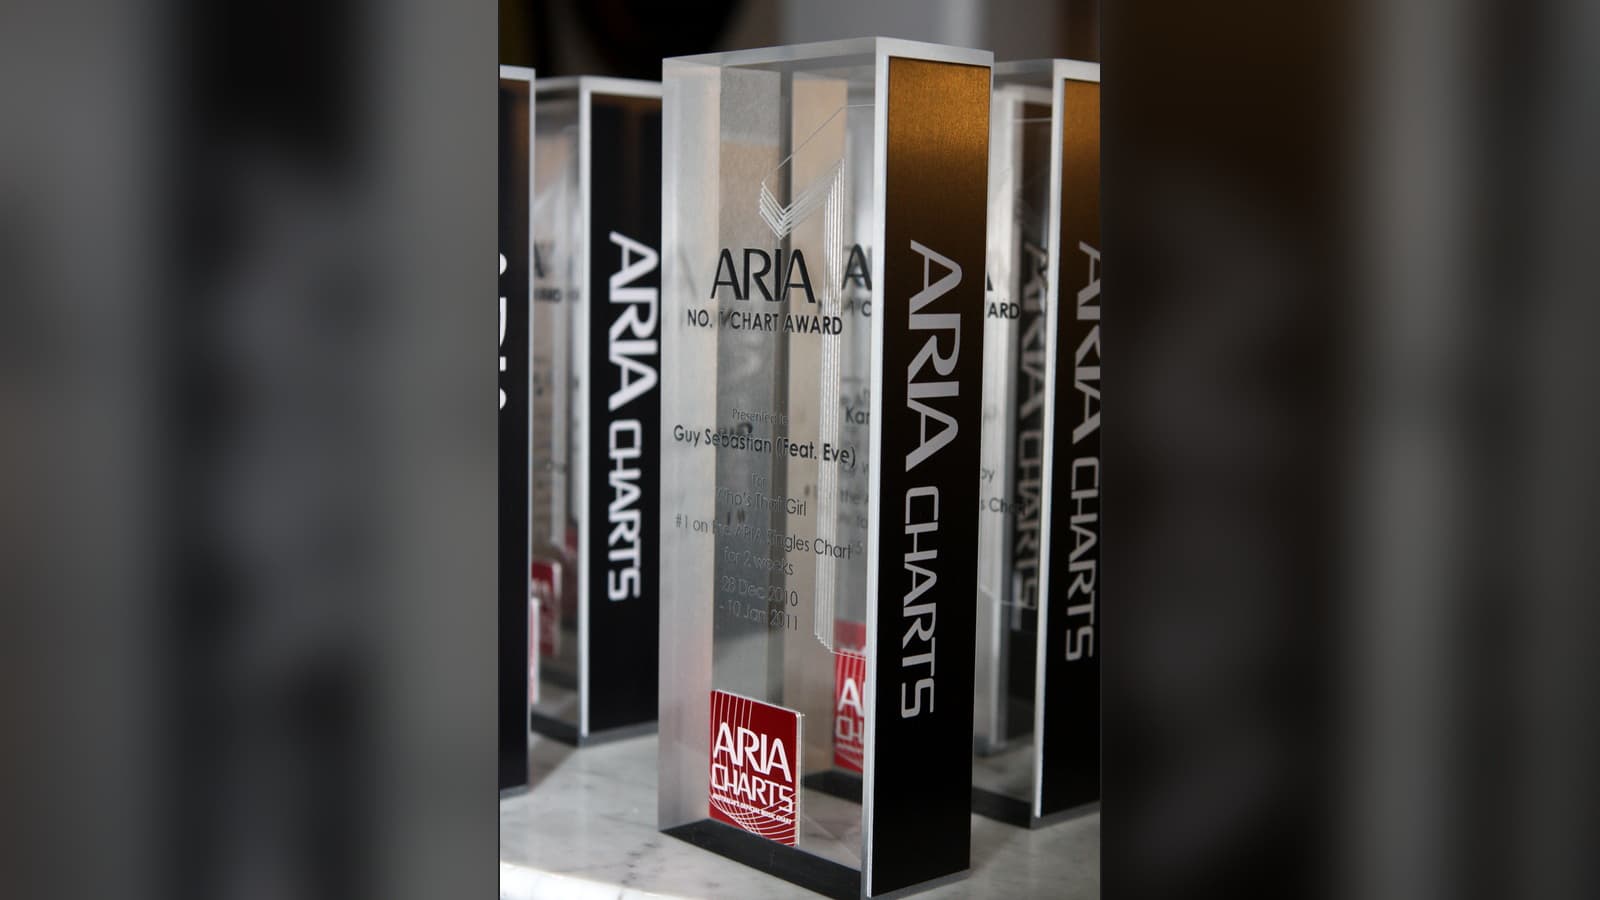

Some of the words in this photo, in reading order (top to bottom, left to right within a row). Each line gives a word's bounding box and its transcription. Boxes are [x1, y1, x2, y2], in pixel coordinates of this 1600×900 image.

[710, 248, 816, 303] ARIA
[609, 231, 659, 412] ARIA
[688, 309, 713, 328] NO.
[731, 311, 779, 331] CHART
[784, 315, 842, 335] AWARD
[986, 302, 1020, 320] ARD
[906, 239, 963, 473] ARIA
[673, 425, 700, 447] Guy
[705, 429, 771, 453] Sebastian
[775, 436, 817, 460] (Feat.
[823, 444, 857, 468] Eve)
[608, 420, 641, 601] CHARTS
[675, 513, 688, 529] #1
[693, 519, 708, 533] on
[786, 499, 806, 517] Girl
[754, 555, 794, 576] weeks
[1065, 456, 1100, 662] CHARTS
[739, 579, 765, 600] Dec
[768, 583, 798, 607] 2010
[901, 486, 939, 718] CHARTS
[743, 605, 768, 624] Jan
[770, 609, 798, 631] 2011
[713, 722, 793, 783] ARIA
[711, 763, 793, 813] CHARTS
